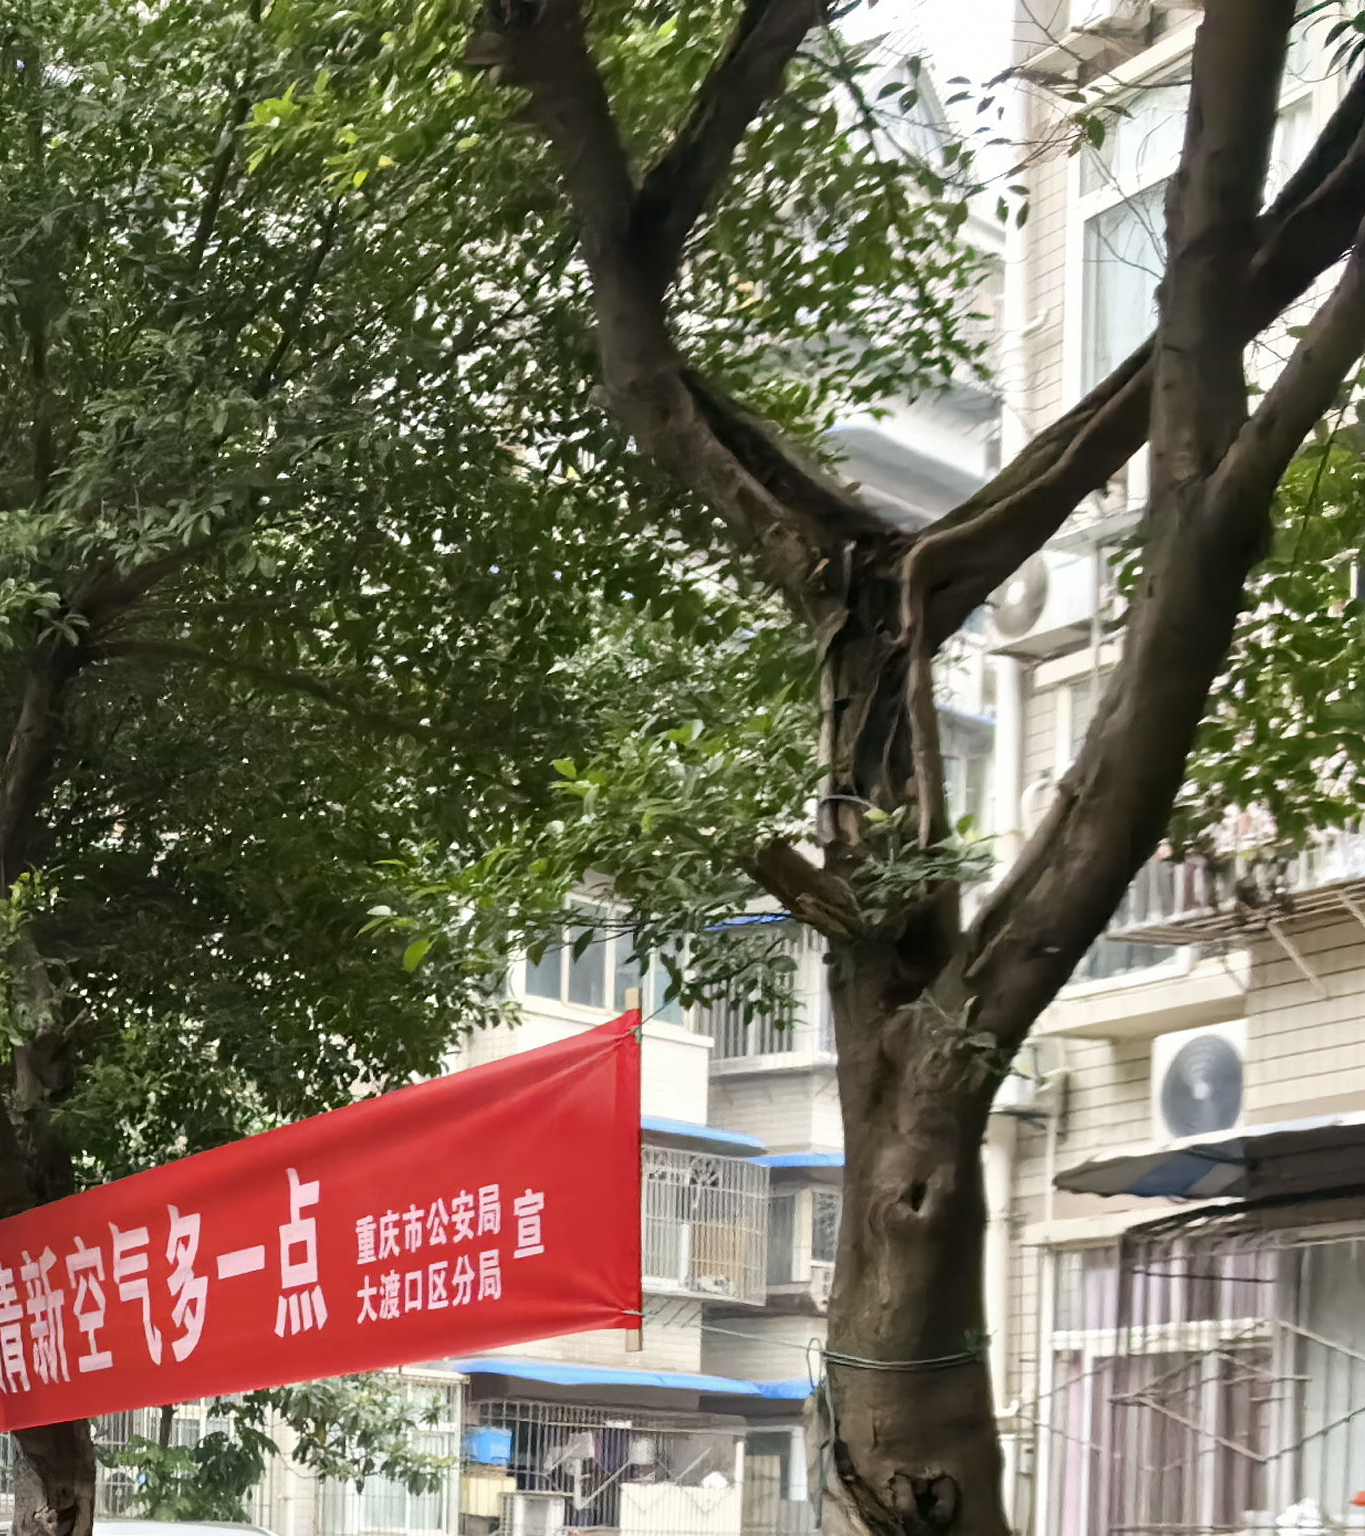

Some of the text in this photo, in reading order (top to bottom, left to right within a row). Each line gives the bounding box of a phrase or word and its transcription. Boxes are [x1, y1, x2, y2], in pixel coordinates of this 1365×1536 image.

[356, 1184, 501, 1265] 重庆市公安局
[513, 1188, 545, 1259] 宣
[356, 1249, 502, 1325] 大渡口区分局
